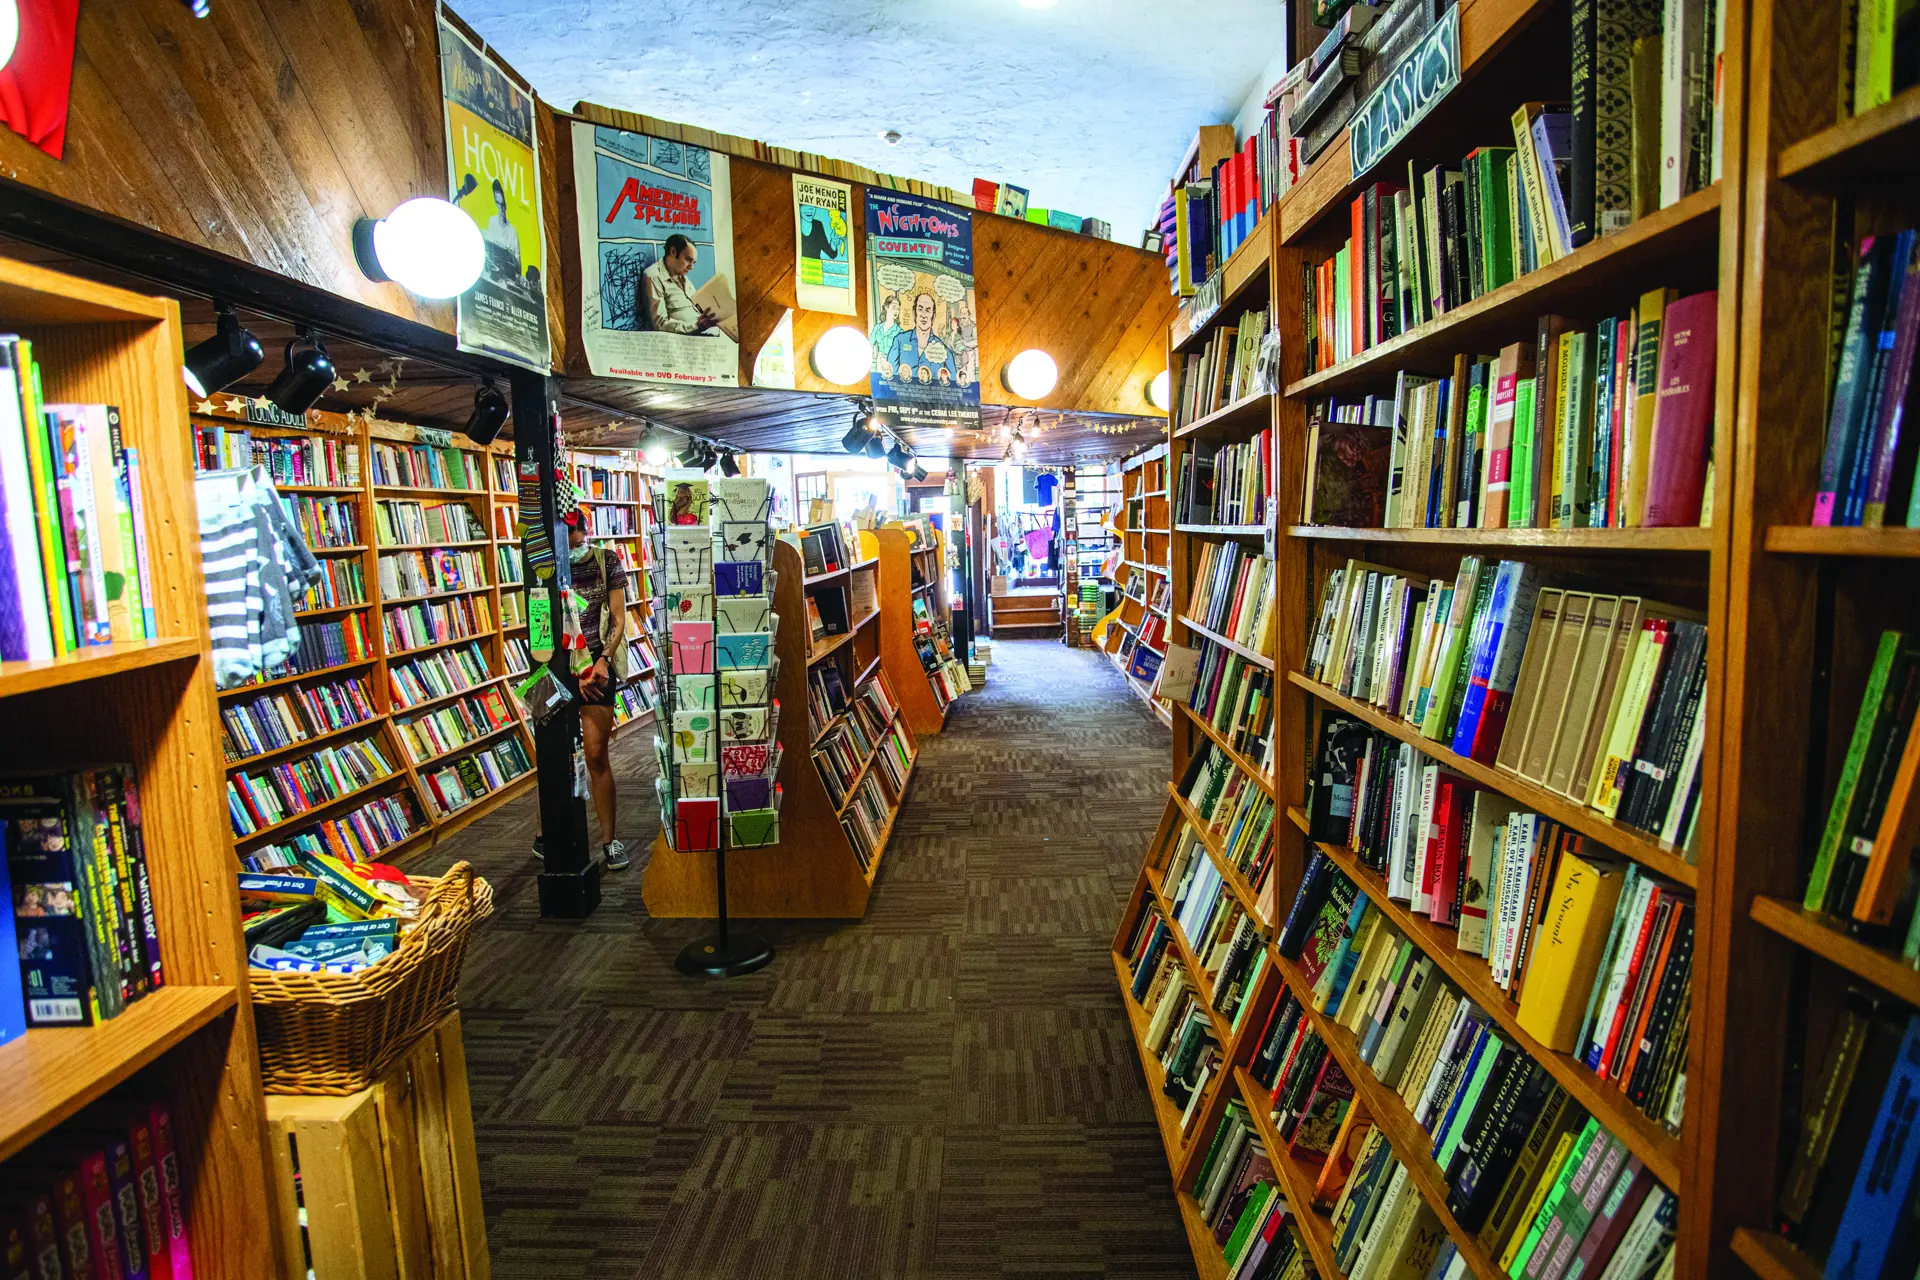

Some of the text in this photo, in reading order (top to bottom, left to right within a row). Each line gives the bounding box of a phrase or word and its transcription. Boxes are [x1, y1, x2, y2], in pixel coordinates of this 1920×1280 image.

[1354, 17, 1452, 172] CLASSICS
[462, 124, 531, 207] HOWL
[1522, 147, 1532, 178] Mayor
[799, 184, 837, 199] JOE MENO
[1528, 176, 1534, 188] of
[605, 177, 699, 224] AMERICAN
[799, 194, 837, 209] JAY RYAN
[634, 203, 701, 227] SPLENDOR
[1530, 187, 1544, 244] Casterbridge
[878, 241, 940, 256] COVENTRY
[948, 244, 966, 252] Everyone
[475, 290, 538, 324] JAMES FRANCO ALLEN GINSBERG
[1674, 330, 1692, 341] VICTOR
[1674, 338, 1688, 348] HUGO
[609, 366, 643, 377] Available
[674, 372, 706, 382] February
[1560, 348, 1568, 392] MODERN
[1670, 376, 1680, 386] LES
[1496, 388, 1514, 401] ODYSSEY
[1502, 378, 1510, 390] THE
[248, 400, 280, 424] YOUNG
[888, 405, 898, 414] FRI,
[931, 409, 948, 418] CEDAR
[1466, 398, 1478, 422] Go
[1536, 374, 1545, 433] Hermaphrodite
[1557, 395, 1566, 445] INSTANCE
[1423, 444, 1431, 473] Gertrude
[84, 471, 94, 512] PRINCESS
[122, 529, 142, 618] STONE HEART
[1383, 591, 1392, 608] The
[1354, 580, 1375, 677] LOTTERY SHIRLEY JACKSON
[1379, 608, 1389, 633] Wings
[1378, 633, 1385, 642] of
[1373, 657, 1381, 678] Dove
[1683, 697, 1692, 716] THREE
[1688, 698, 1697, 718] THREE
[1675, 745, 1684, 761] BOAT
[1603, 757, 1615, 781] SAVES
[1608, 759, 1619, 781] USED
[1396, 770, 1404, 800] KEROUAC
[1422, 773, 1432, 811] KEROUAC
[1379, 777, 1393, 846] DESOLATION ANGELS
[1395, 802, 1401, 811] ON
[1419, 830, 1426, 842] ON
[108, 803, 133, 913] THE ADVENTURE ZONE
[1433, 824, 1445, 884] DEMON BOX
[265, 879, 282, 887] PRINT
[1533, 856, 1544, 886] STRUGGLE
[339, 882, 367, 905] OUT OF PRINT
[1335, 877, 1356, 898] TO KILL
[1501, 867, 1513, 922] KNAUSGAARD
[1504, 822, 1528, 959] KARL OVE KNAUSGAARD WINTER
[1549, 868, 1582, 949] My Struggle
[143, 914, 156, 939] BOY
[351, 924, 368, 932] PRINT
[1631, 899, 1654, 967] MILAN KUNDERA
[315, 949, 334, 960] PRINT
[341, 942, 357, 952] OUT
[1496, 927, 1505, 962] AUTUMN
[1516, 928, 1529, 968] KNAUSGAARD
[1300, 951, 1312, 966] HARPER
[1397, 996, 1442, 1090] Arrowsmith Sinclair Lewis
[1460, 1038, 1476, 1069] Babbitt
[1329, 1066, 1342, 1080] The
[1430, 1058, 1453, 1104] MAIN STREET
[1434, 1062, 1457, 1109] SINCLAIR LEWIS
[1447, 1069, 1463, 1098] Sinclair
[1322, 1078, 1352, 1095] Splendid
[1472, 1053, 1521, 1157] MALCOLM LOWRY
[1479, 1062, 1531, 1170] PURSUED BY FURIES
[1547, 1136, 1568, 1173] Midaq Alley
[1354, 1170, 1404, 1277] AT PLAY IN THE FIELDS OF THE
